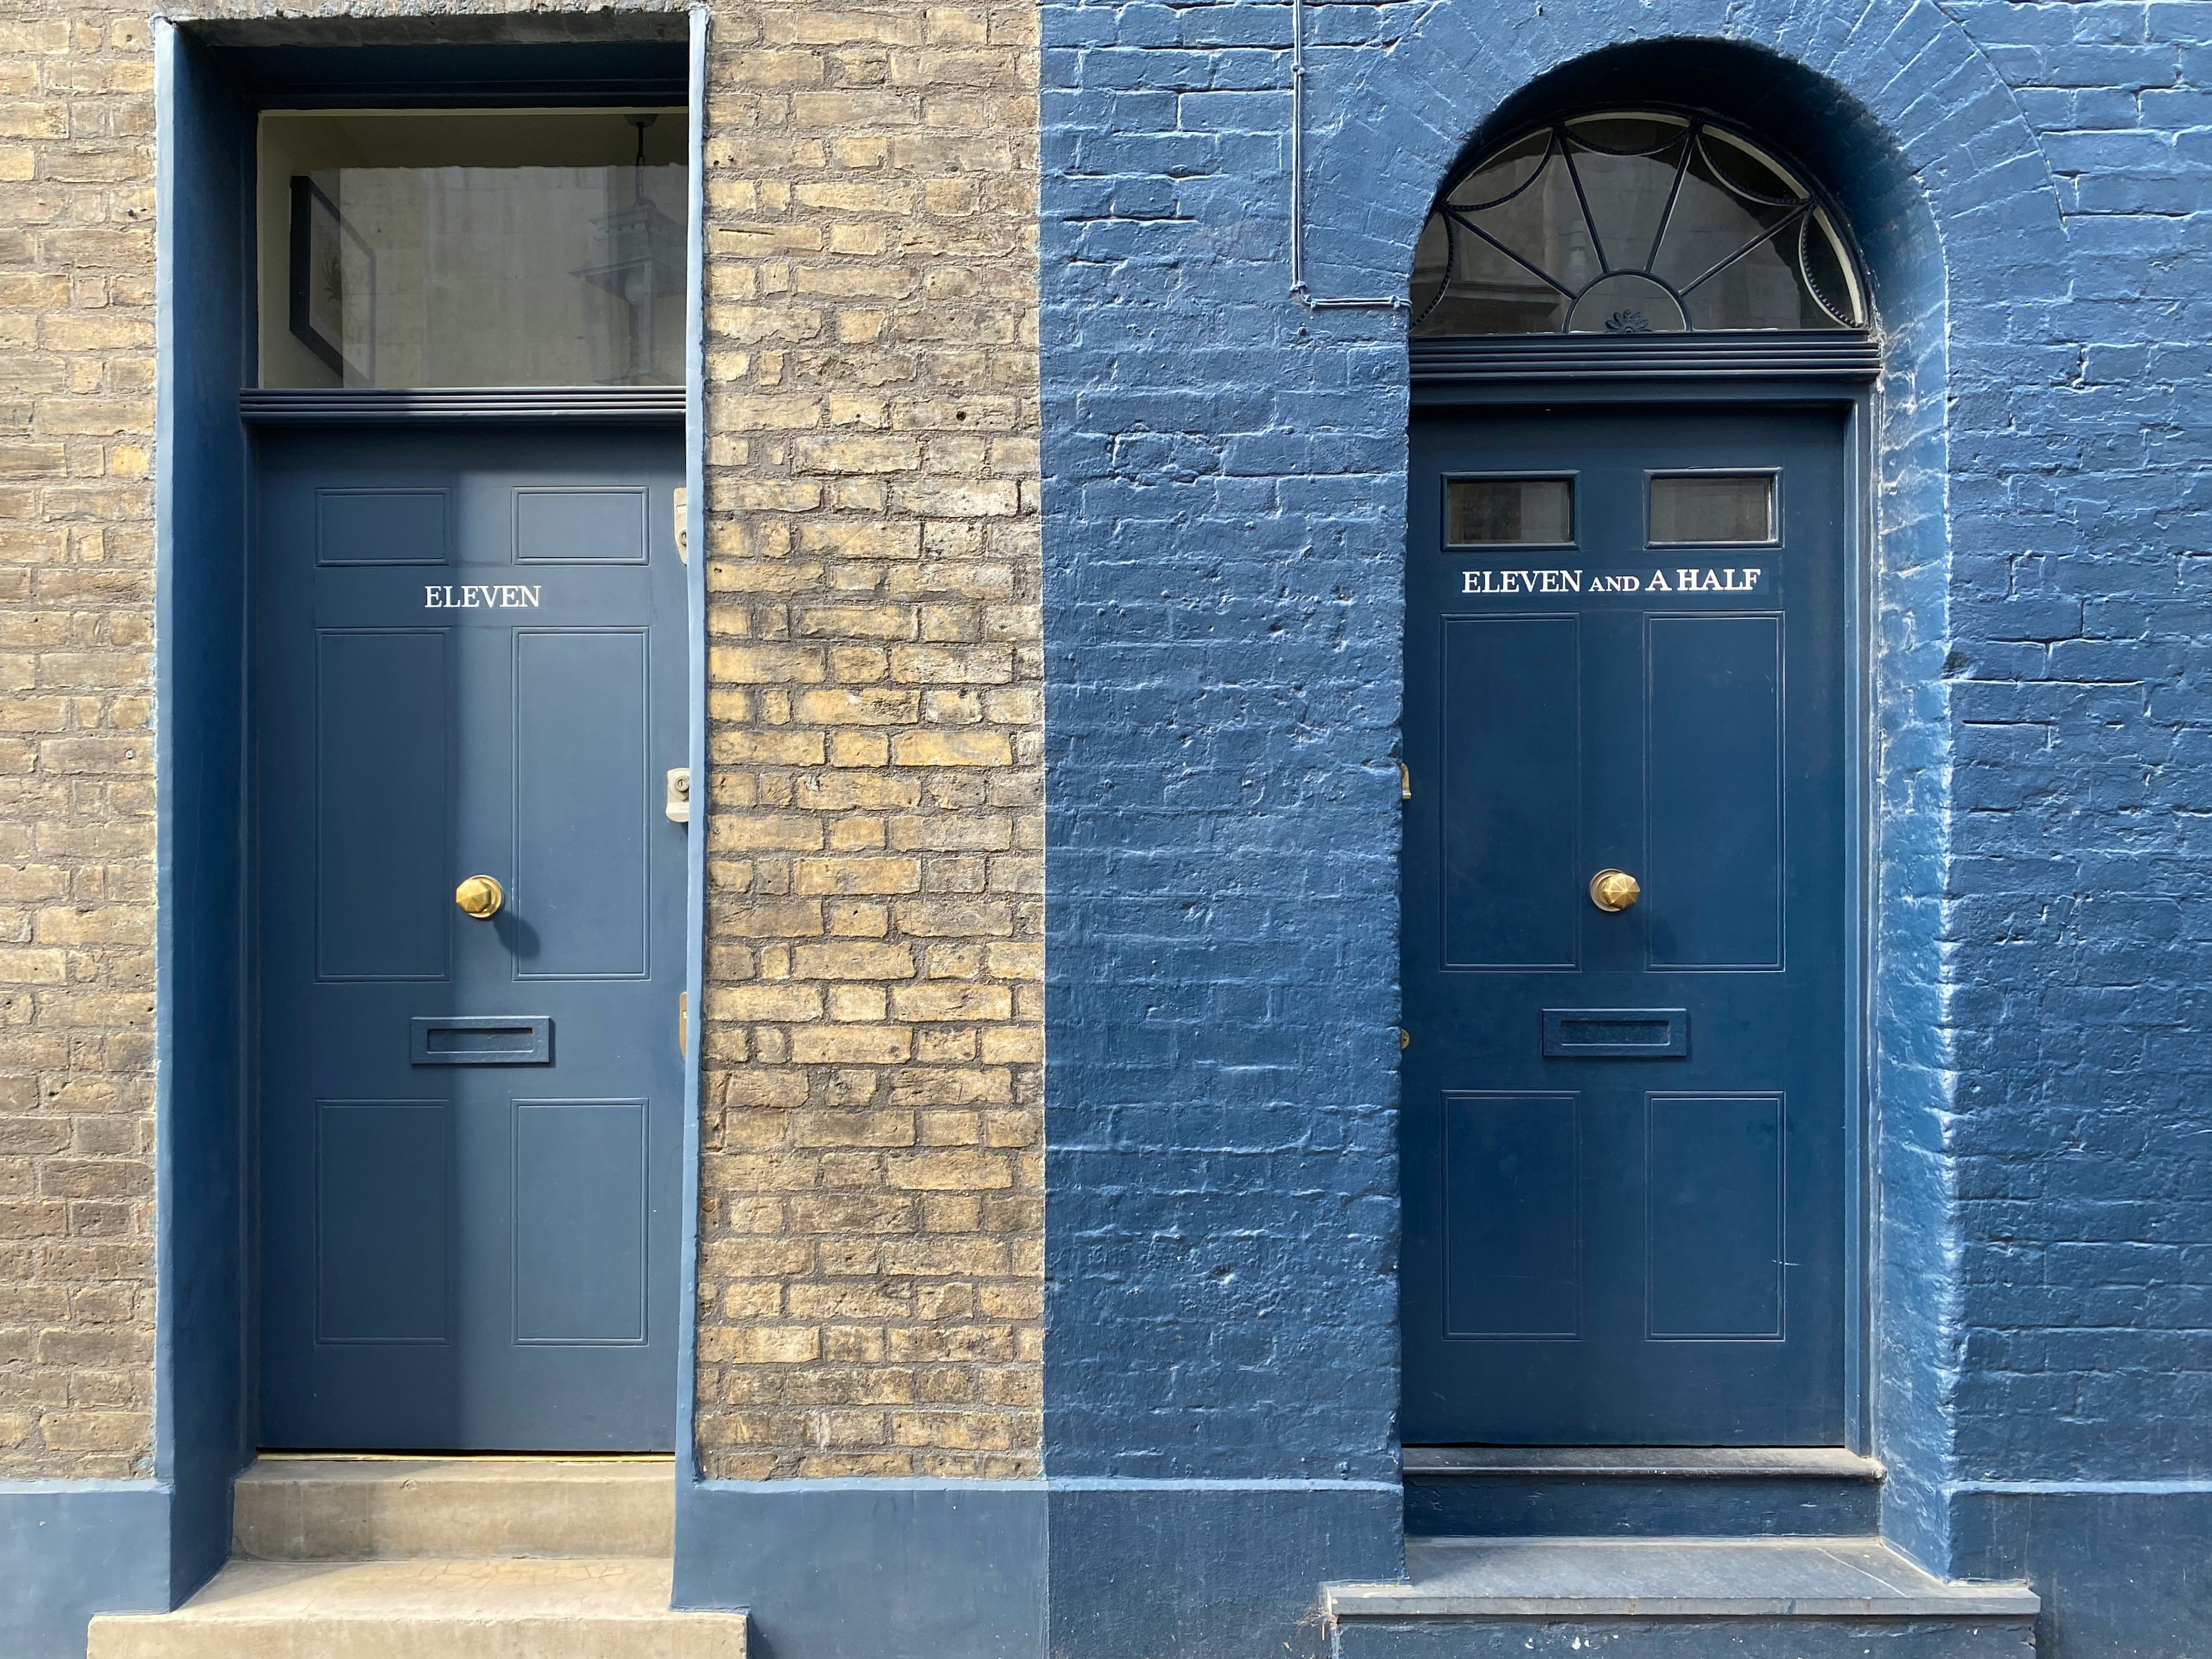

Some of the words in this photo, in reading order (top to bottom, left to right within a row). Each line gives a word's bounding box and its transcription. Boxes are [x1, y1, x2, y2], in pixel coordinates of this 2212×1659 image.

[1461, 570, 1583, 593] ELEVEN
[1588, 576, 1640, 592] AND
[1644, 569, 1673, 592] A
[1676, 568, 1761, 591] HALF
[425, 585, 542, 608] ELEVEN
